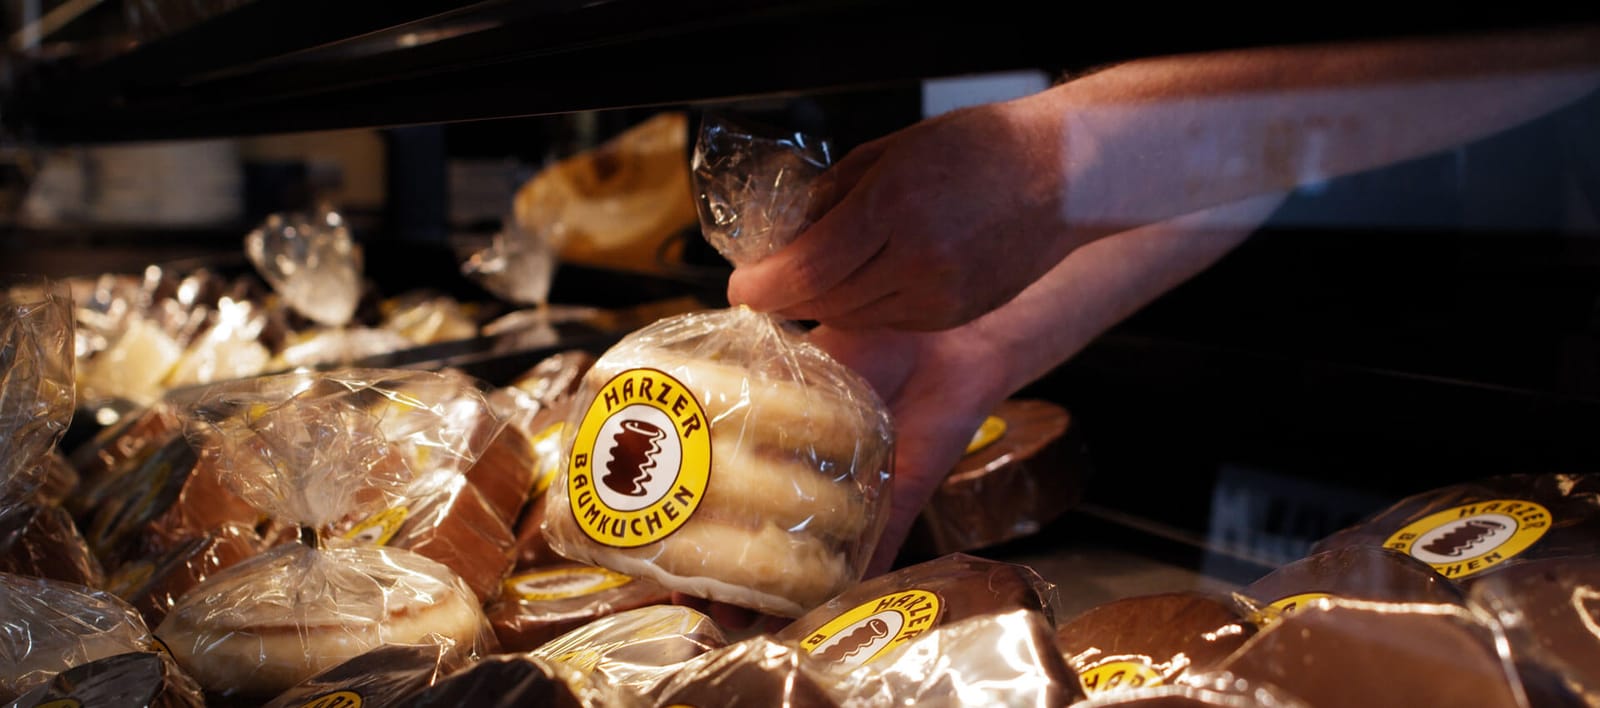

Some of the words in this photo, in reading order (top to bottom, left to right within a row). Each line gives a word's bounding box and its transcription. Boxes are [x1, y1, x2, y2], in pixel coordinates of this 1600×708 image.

[603, 377, 701, 439] HARZER
[573, 453, 695, 538] BAUMKUCHEN
[1459, 503, 1547, 531] HARZER
